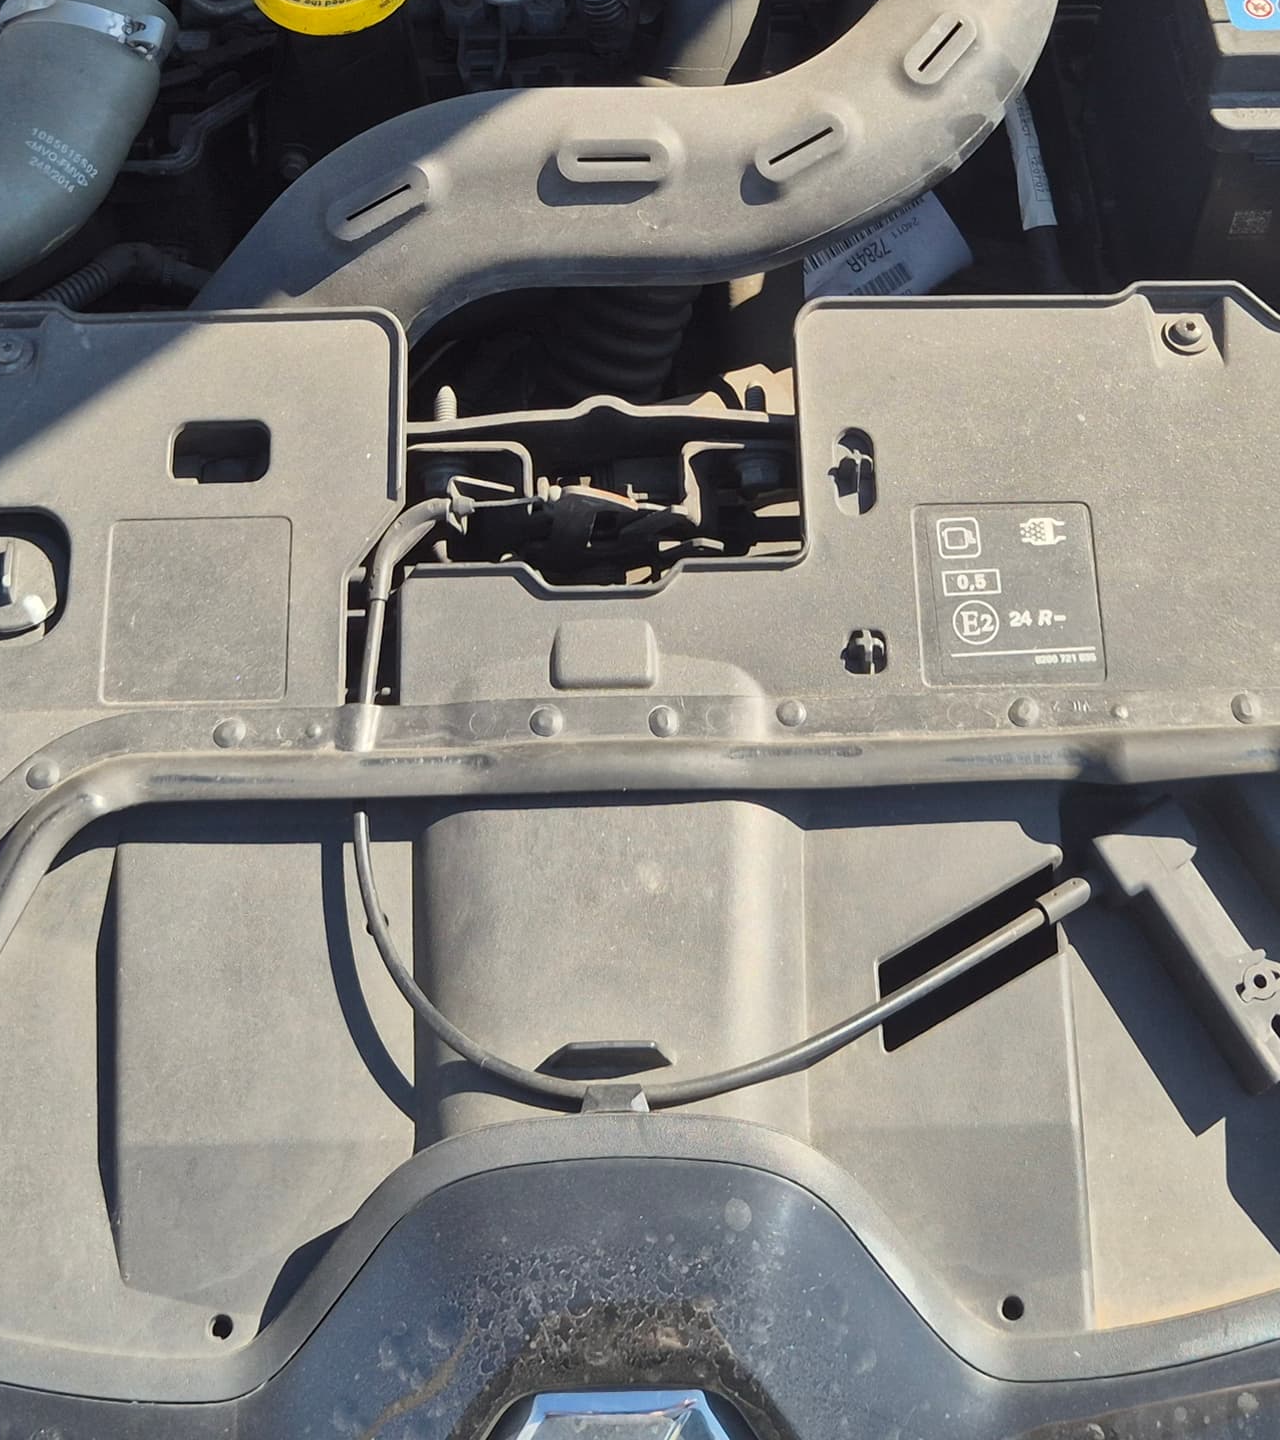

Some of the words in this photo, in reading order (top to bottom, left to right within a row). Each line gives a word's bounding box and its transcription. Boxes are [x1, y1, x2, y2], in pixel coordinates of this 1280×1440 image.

[304, 0, 323, 7] the
[846, 238, 894, 274] 7284R
[956, 574, 987, 591] 0,5
[960, 611, 995, 637] E2
[1009, 610, 1033, 628] 24
